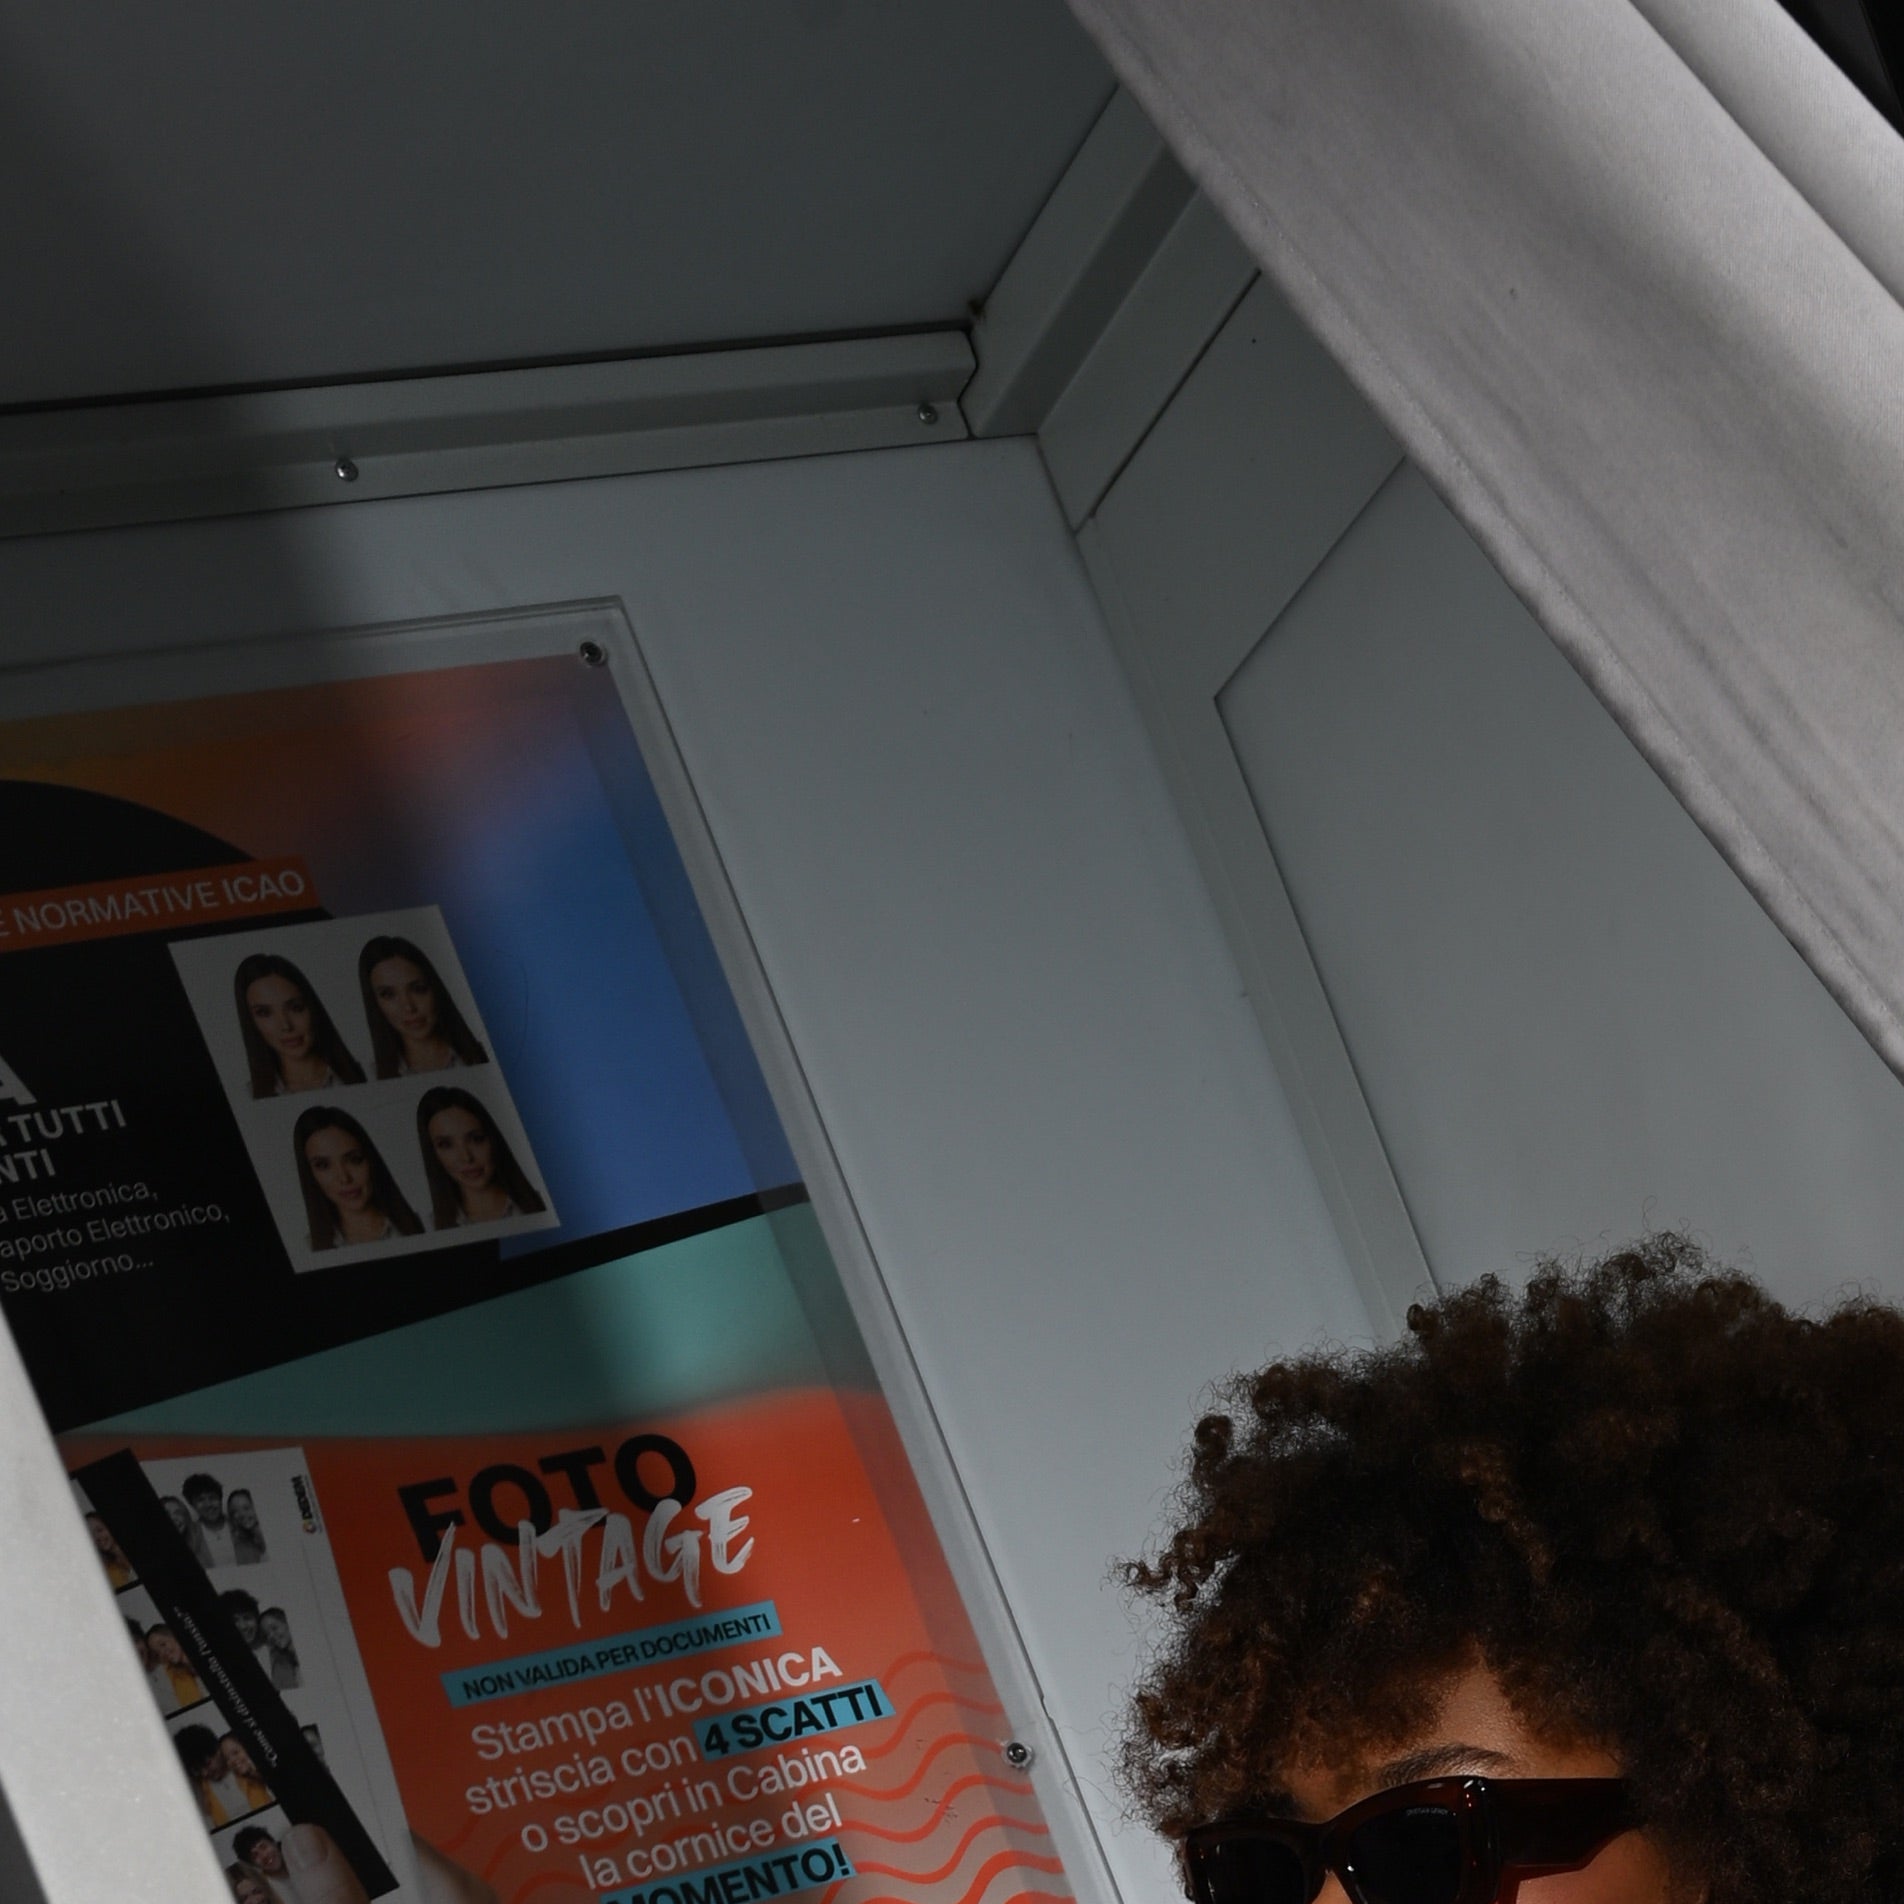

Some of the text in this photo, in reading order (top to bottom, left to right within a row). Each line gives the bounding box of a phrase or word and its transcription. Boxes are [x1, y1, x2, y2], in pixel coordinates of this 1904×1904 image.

[13, 881, 219, 934] NORMATIVE
[221, 870, 304, 904] ICAO
[7, 1099, 126, 1142] TUTTI
[14, 1180, 159, 1222] Elettronica,
[88, 1201, 230, 1244] Elettronico,
[2, 1254, 154, 1294] Soggiorno...
[397, 1434, 696, 1564] FOTO
[388, 1486, 754, 1648] VINTAGE
[463, 1613, 770, 1699] NON VALIDA PER DOCUMENTI
[465, 1684, 882, 1814] striscia con 4 SCATTI
[471, 1646, 843, 1760] Stampa l'ICONICA
[521, 1745, 867, 1852] o scopri in Cabina
[579, 1791, 842, 1889] la cornice del
